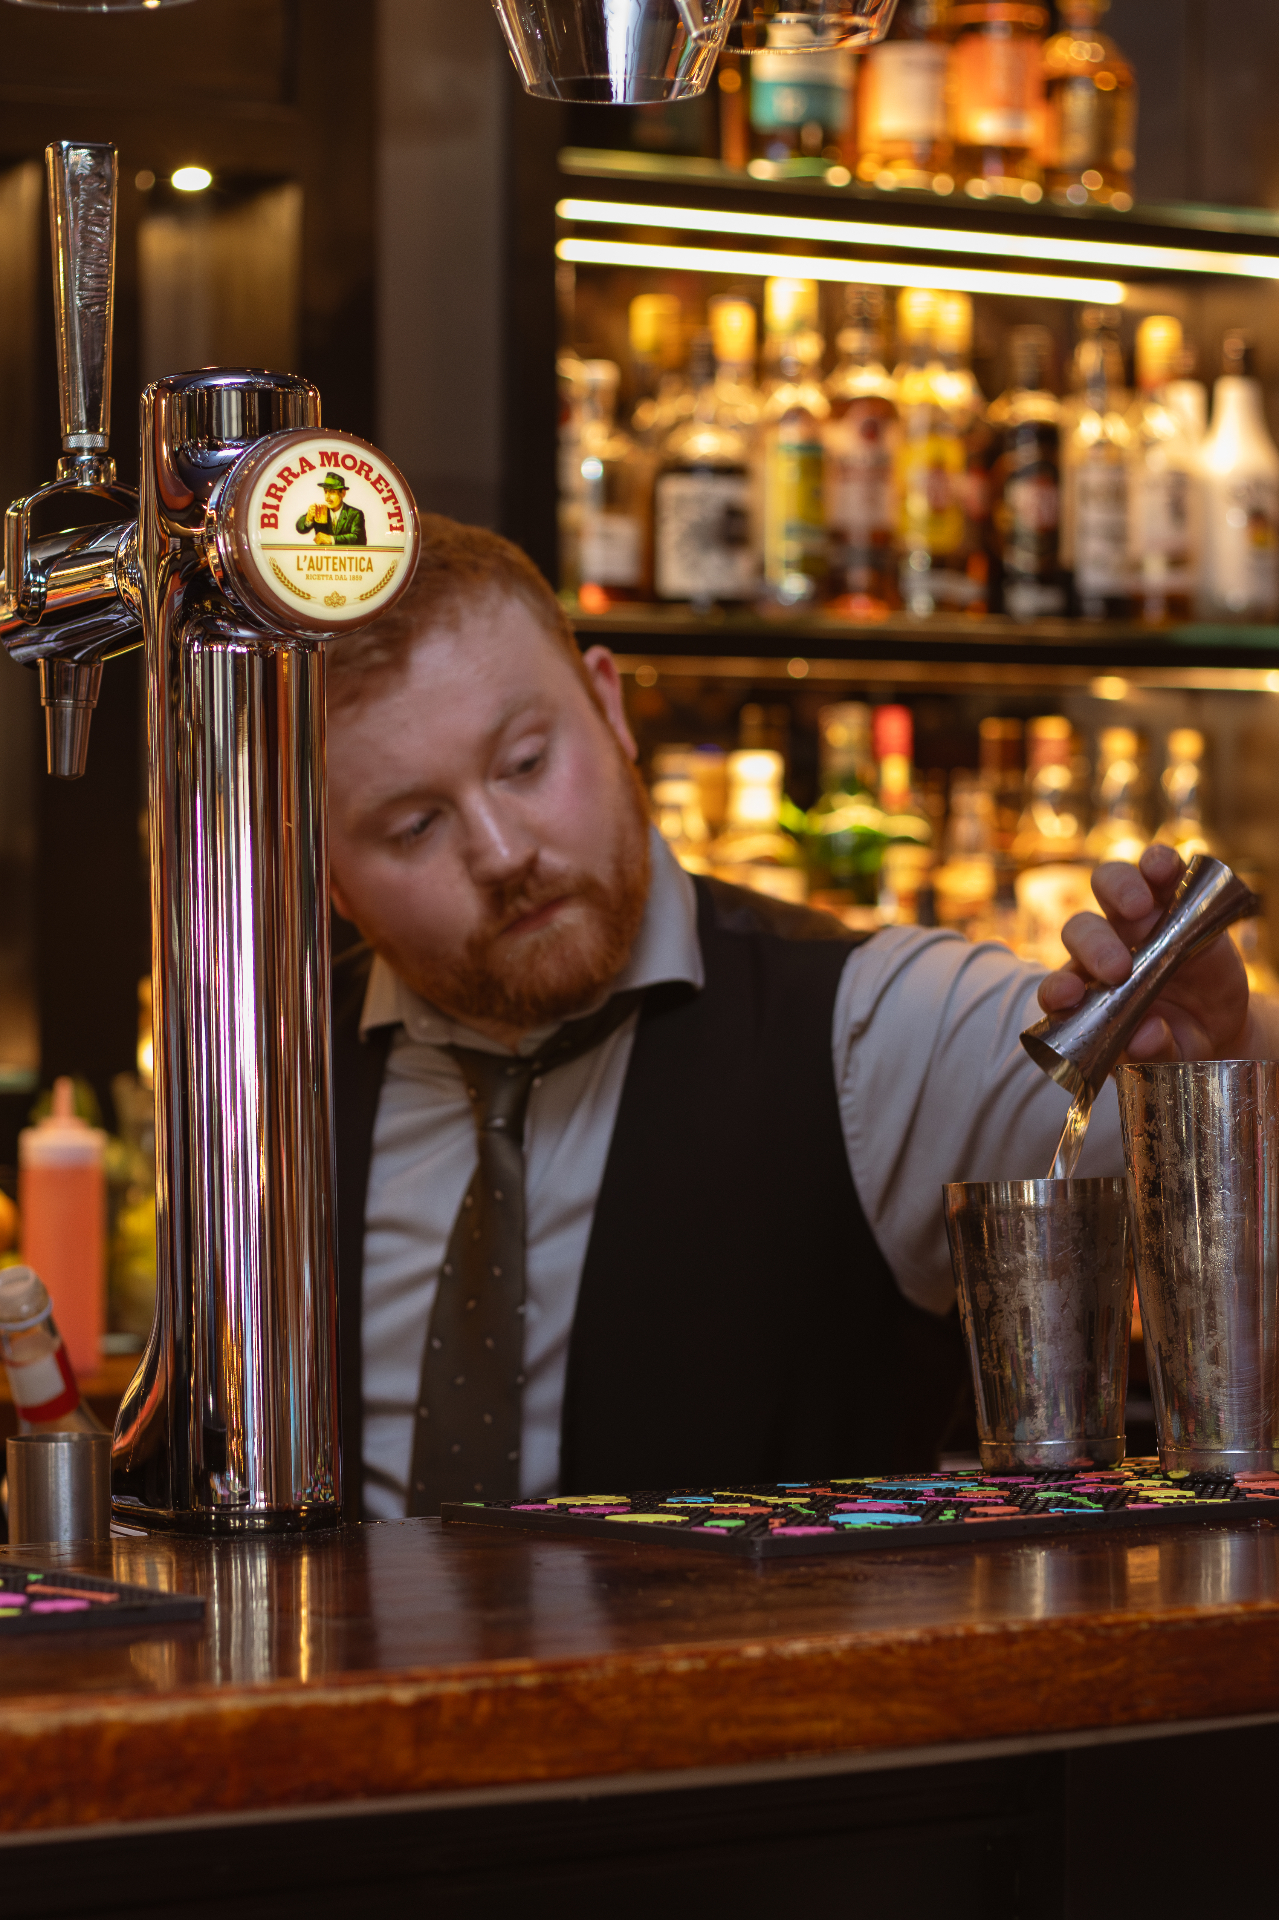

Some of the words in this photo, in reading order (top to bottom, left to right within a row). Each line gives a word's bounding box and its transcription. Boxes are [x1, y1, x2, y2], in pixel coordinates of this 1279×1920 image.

[260, 456, 316, 530] BIRRA
[318, 451, 405, 533] MORETTI
[296, 555, 374, 573] L'AUTENTICA
[305, 573, 333, 581] RICETTA
